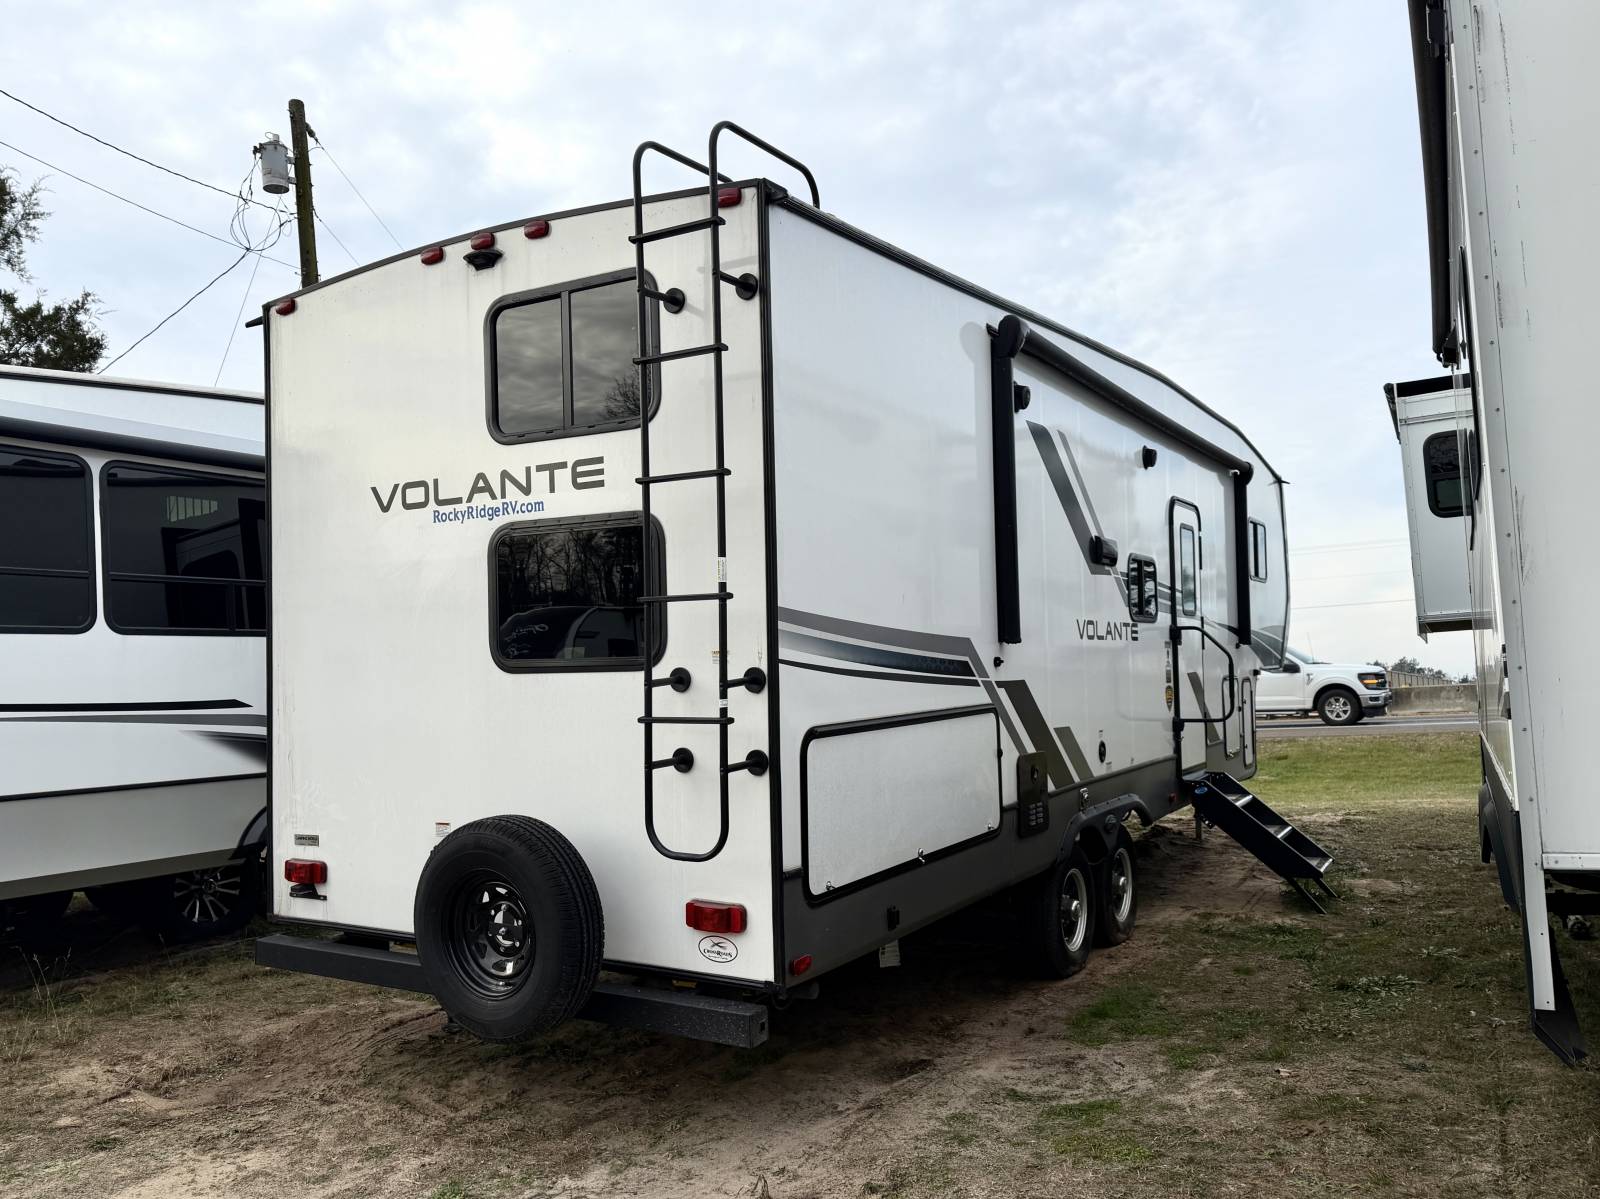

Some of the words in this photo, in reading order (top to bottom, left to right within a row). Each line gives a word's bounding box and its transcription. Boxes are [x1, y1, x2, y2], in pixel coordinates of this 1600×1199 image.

[370, 456, 605, 513] VOLANTE
[432, 500, 545, 524] RockyRidgeRV.com
[1076, 619, 1139, 641] VOLANTE
